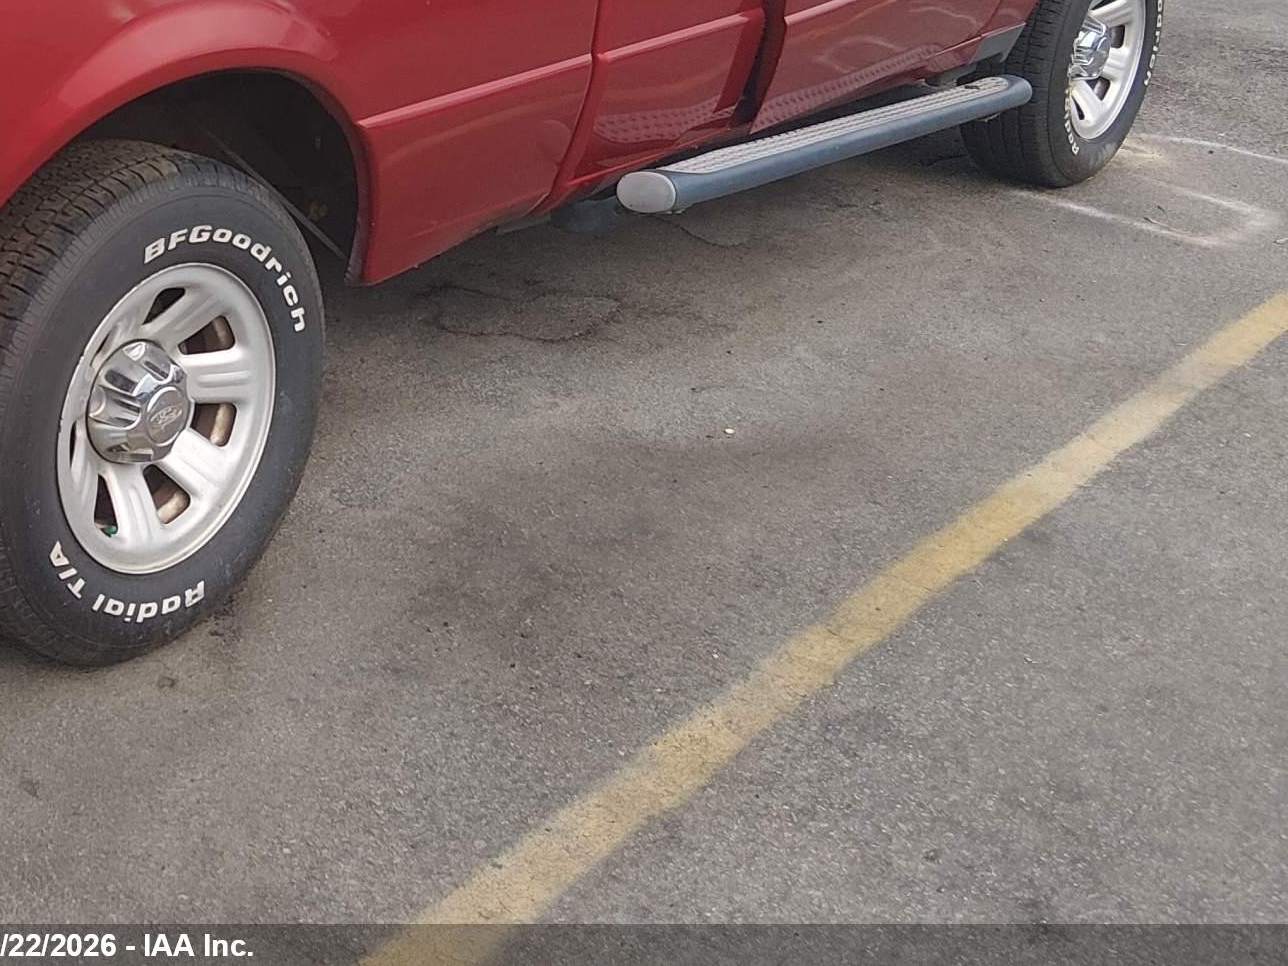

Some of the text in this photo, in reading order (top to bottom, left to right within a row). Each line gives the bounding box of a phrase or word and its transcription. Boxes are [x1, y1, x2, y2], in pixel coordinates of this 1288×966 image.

[144, 224, 306, 332] BFGoodrich
[49, 540, 205, 623] Radial T/A
